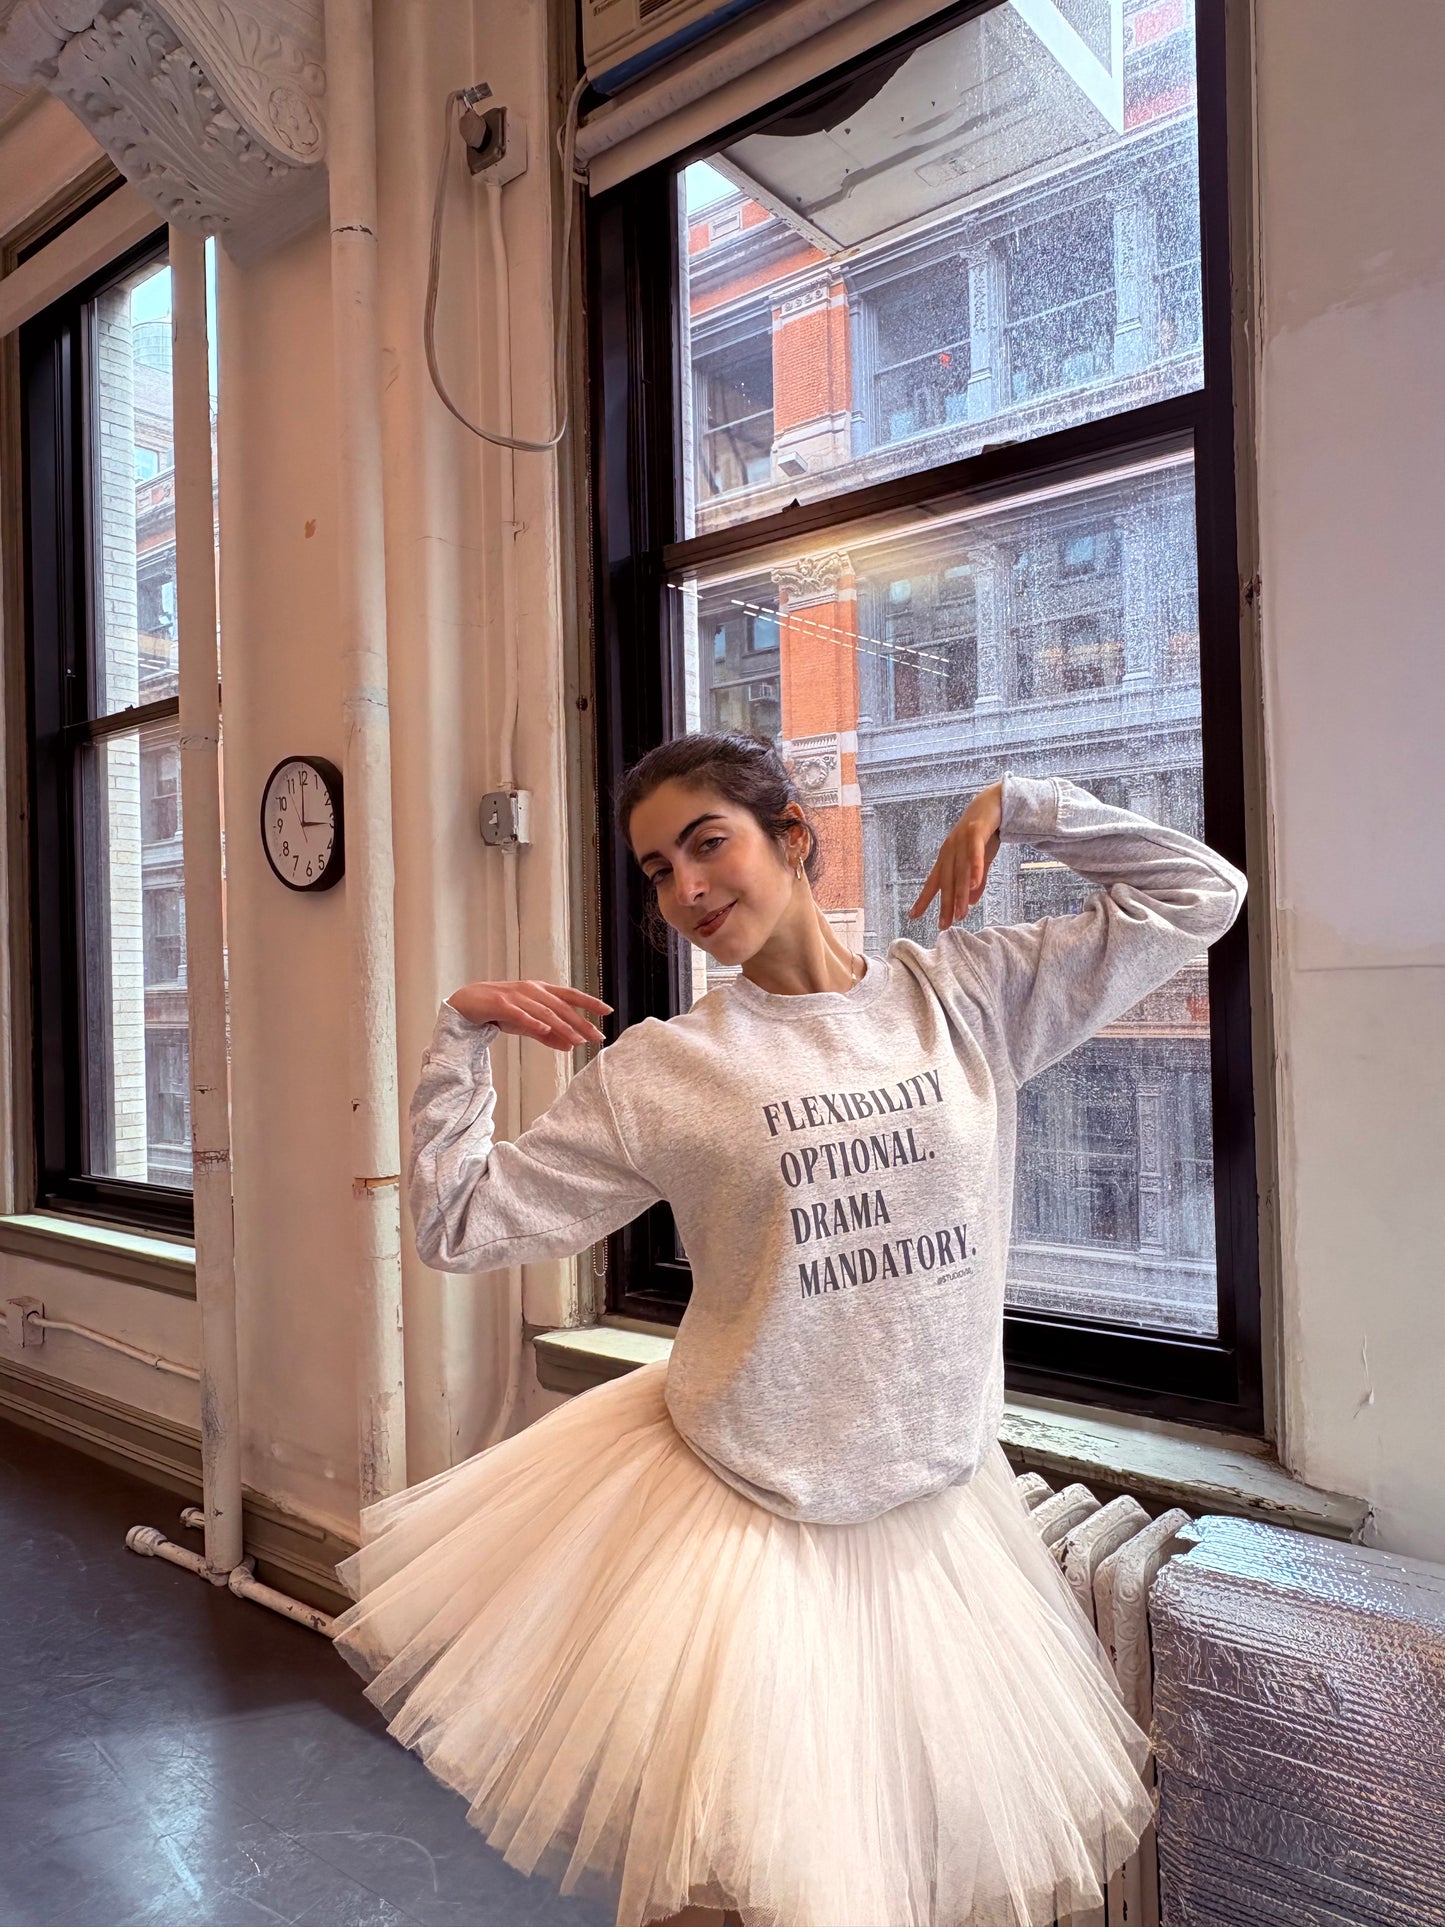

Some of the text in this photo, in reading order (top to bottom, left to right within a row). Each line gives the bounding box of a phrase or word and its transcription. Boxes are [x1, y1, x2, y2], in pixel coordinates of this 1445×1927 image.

[287, 778, 295, 794] 11
[298, 770, 308, 786] 12
[314, 774, 319, 790] 1
[278, 796, 287, 811] 10
[324, 790, 332, 806] 2
[277, 818, 283, 834] 9
[282, 840, 289, 856] 8
[292, 855, 299, 871] 7
[306, 860, 312, 877] 6
[318, 854, 324, 870] 5
[762, 1069, 943, 1137] FLEXIBILITY
[780, 1128, 935, 1187] OPTIONAL.
[790, 1189, 891, 1245] DRAMA
[798, 1224, 977, 1299] MANDATORY.
